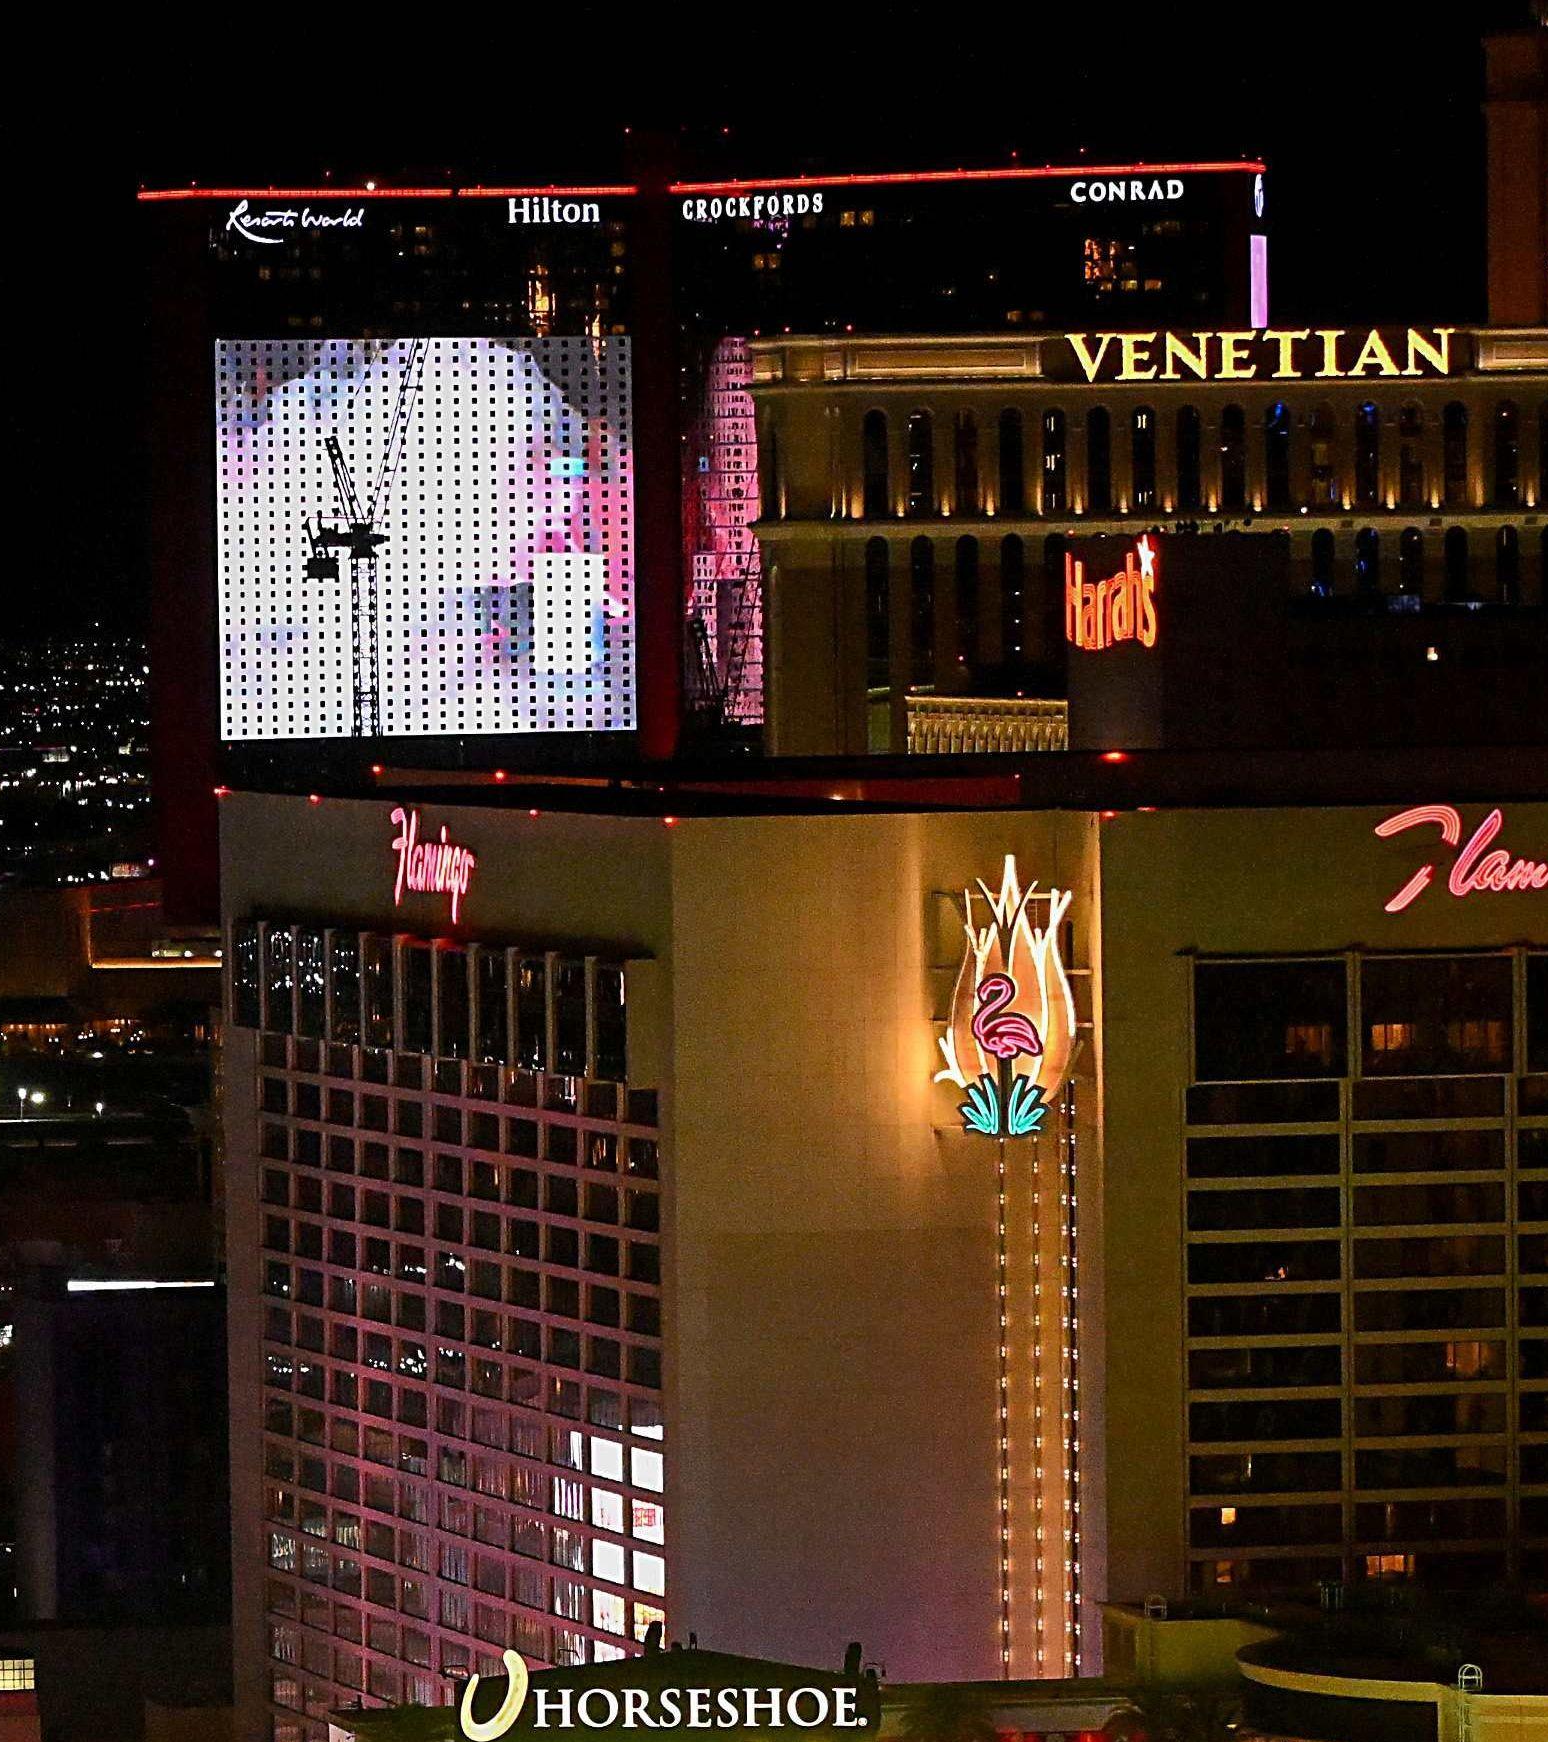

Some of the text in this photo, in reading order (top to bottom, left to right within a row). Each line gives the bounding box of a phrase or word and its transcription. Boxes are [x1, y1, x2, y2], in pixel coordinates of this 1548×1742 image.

[507, 195, 602, 227] Hilton
[682, 192, 825, 220] CROCKFORDS
[1070, 178, 1185, 205] CONRAD
[1065, 328, 1455, 382] VENETIAN
[1065, 533, 1161, 651] Harrah's
[390, 805, 477, 924] Flamingo
[533, 1686, 860, 1728] HORSESHOE
